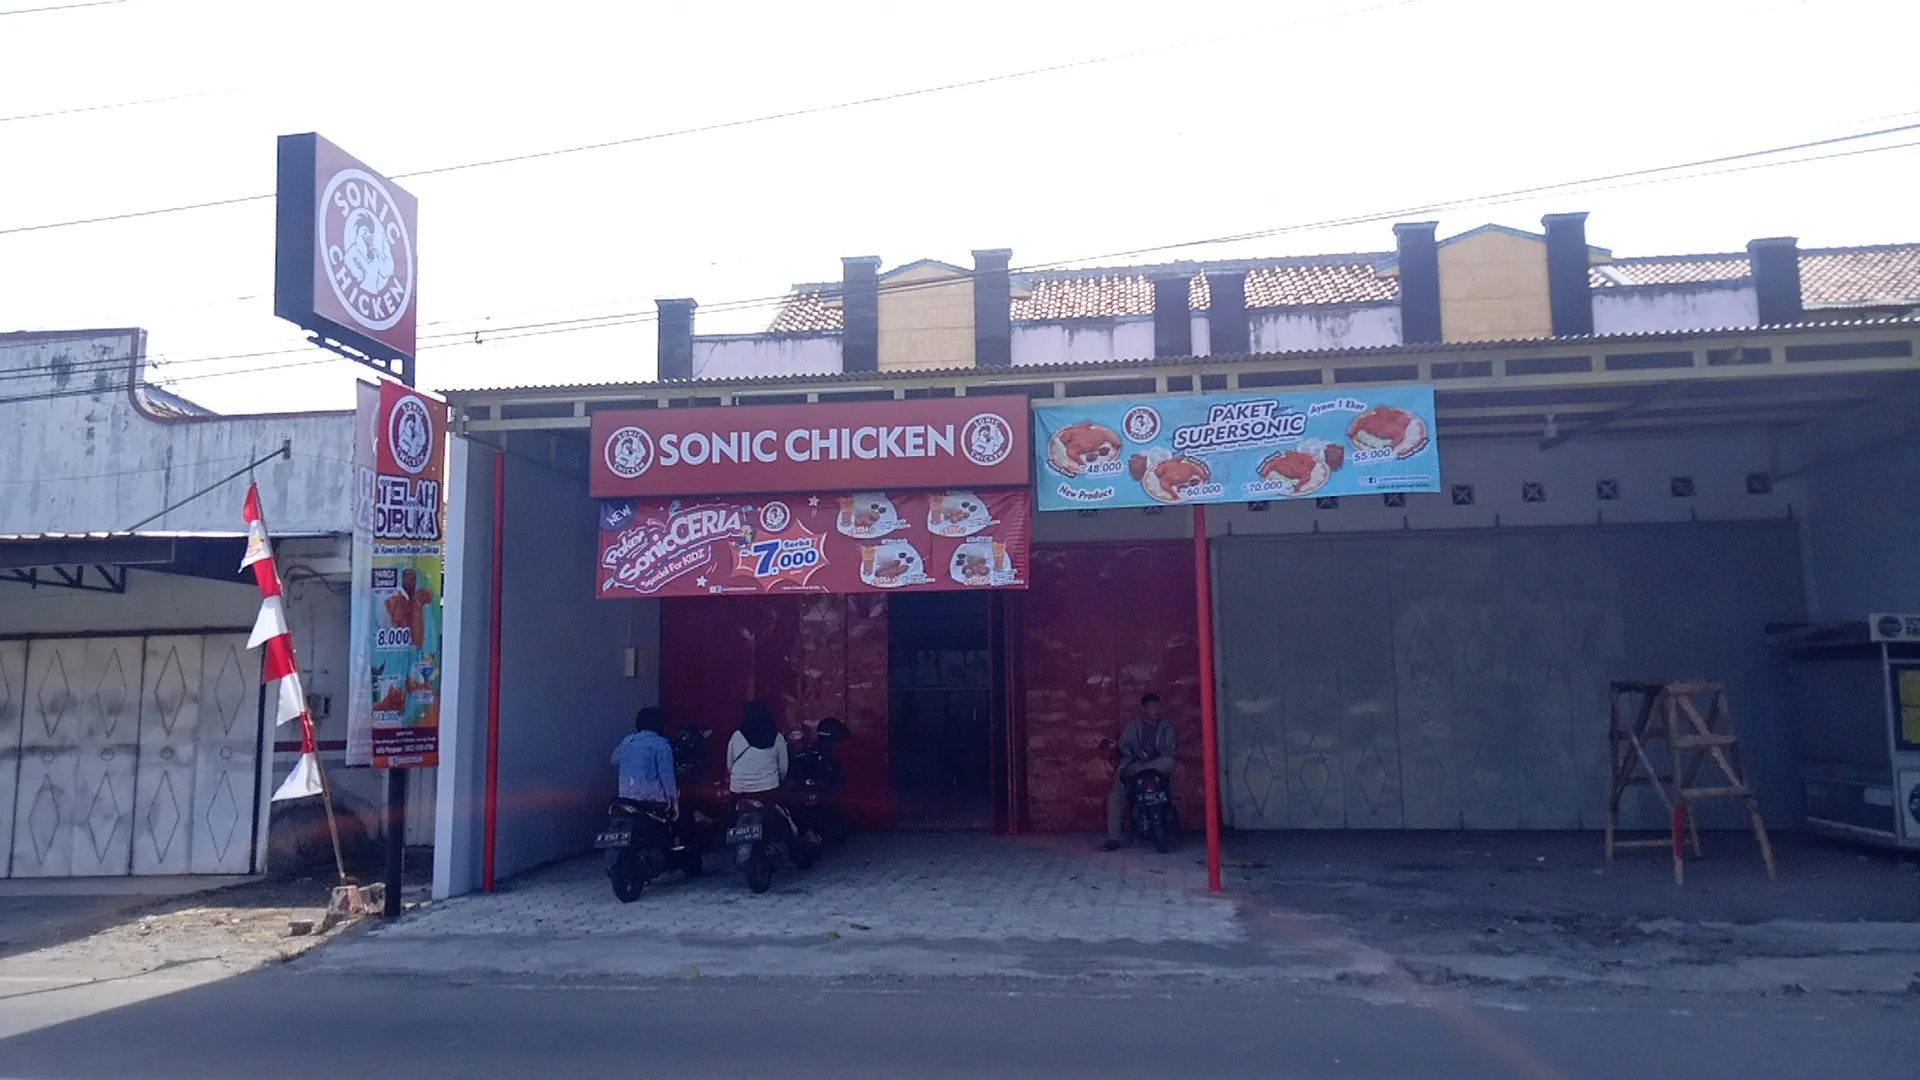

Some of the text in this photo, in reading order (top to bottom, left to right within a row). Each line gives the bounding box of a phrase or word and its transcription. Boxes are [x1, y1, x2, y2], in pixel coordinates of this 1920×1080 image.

[334, 181, 400, 245] SONIC
[328, 245, 405, 319] CHICKEN
[1212, 402, 1275, 422] PAKET
[1310, 403, 1335, 414] Ayam
[1345, 400, 1364, 411] Ekor
[1176, 417, 1304, 446] SUPERSONIC
[659, 424, 955, 466] SONIC CHICKEN
[379, 478, 437, 509] TELAH
[1059, 484, 1112, 499] New Product
[1187, 484, 1220, 496] 60.000
[1249, 480, 1283, 492] 70.000
[376, 507, 436, 535] DIBUKA
[606, 504, 632, 527] NEW
[784, 540, 810, 548] Serba
[668, 561, 684, 573] For
[682, 548, 705, 566] KIDZ
[378, 630, 410, 646] 8.000
